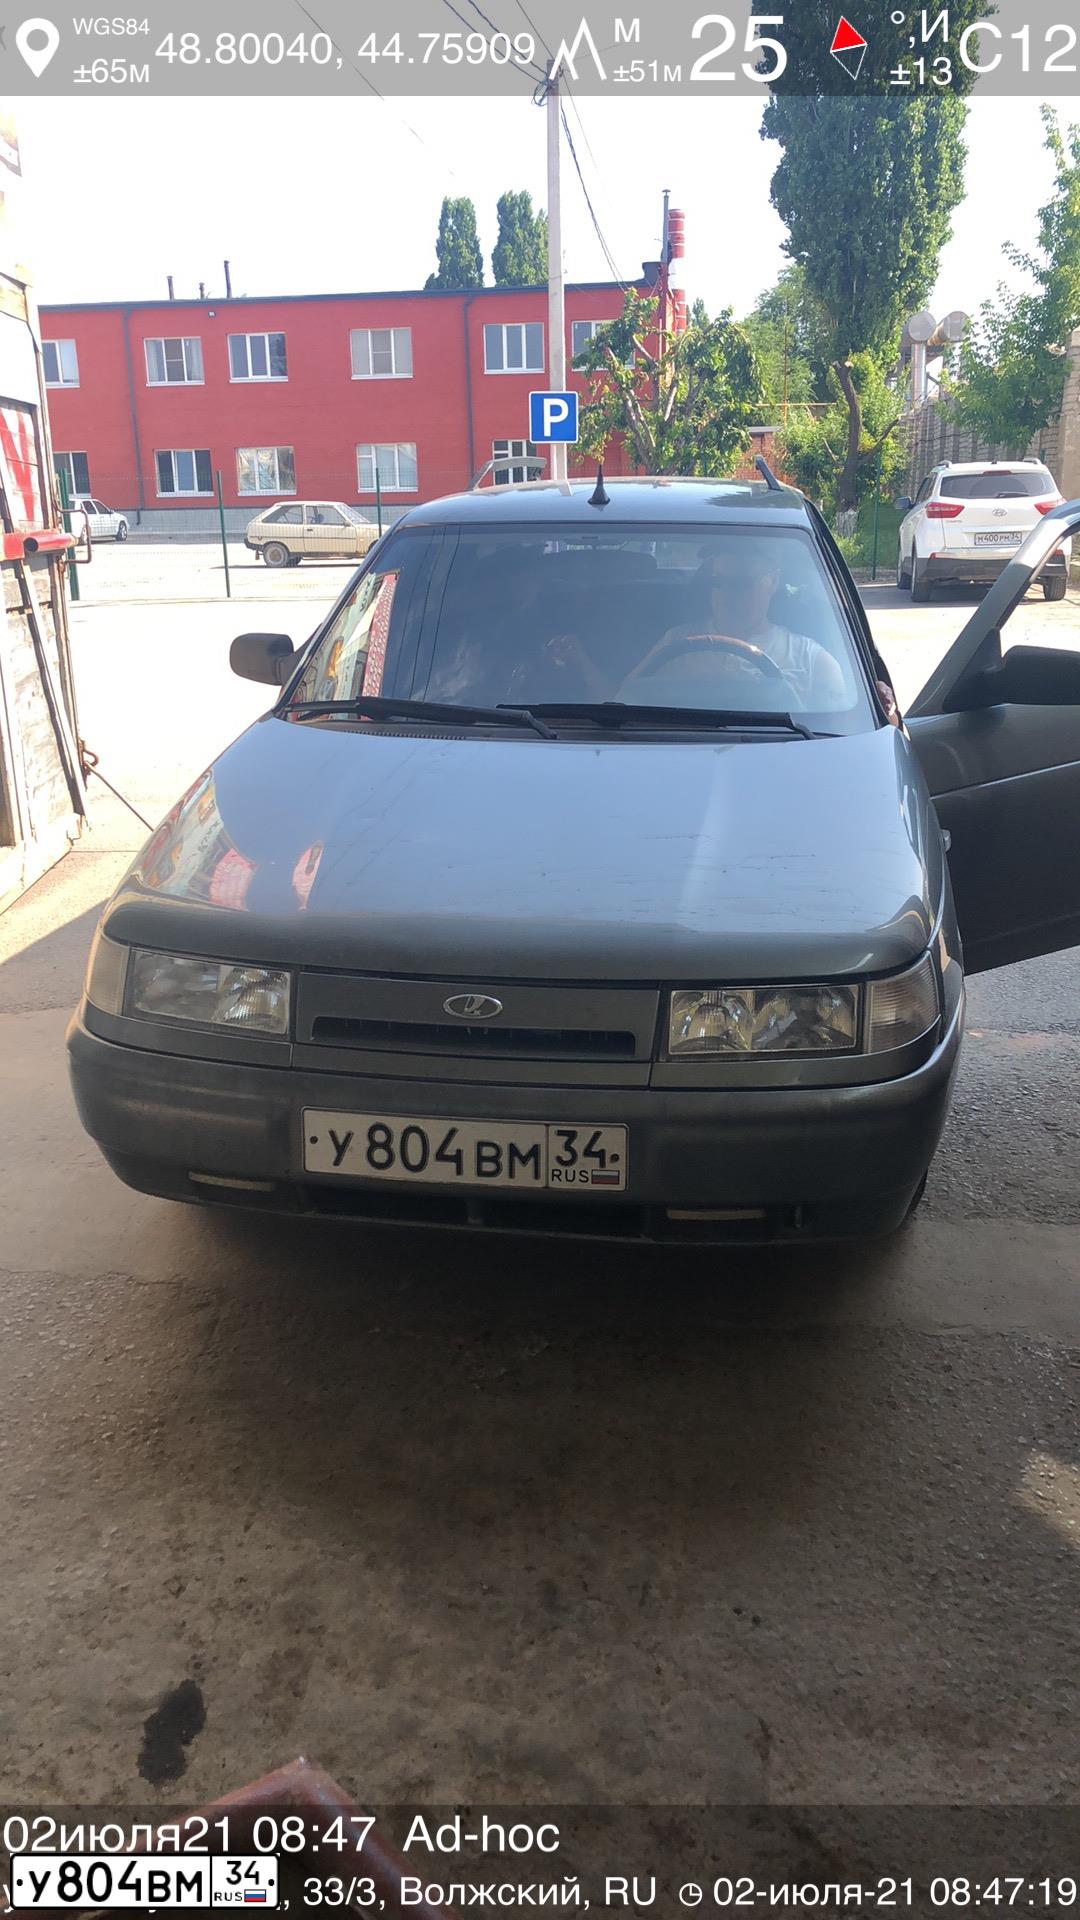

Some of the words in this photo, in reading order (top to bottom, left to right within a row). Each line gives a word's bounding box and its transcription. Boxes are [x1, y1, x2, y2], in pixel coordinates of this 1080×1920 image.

[543, 398, 569, 437] P
[328, 1122, 542, 1180] У804ВМ
[555, 1129, 608, 1169] 34
[551, 1169, 589, 1184] RUS
